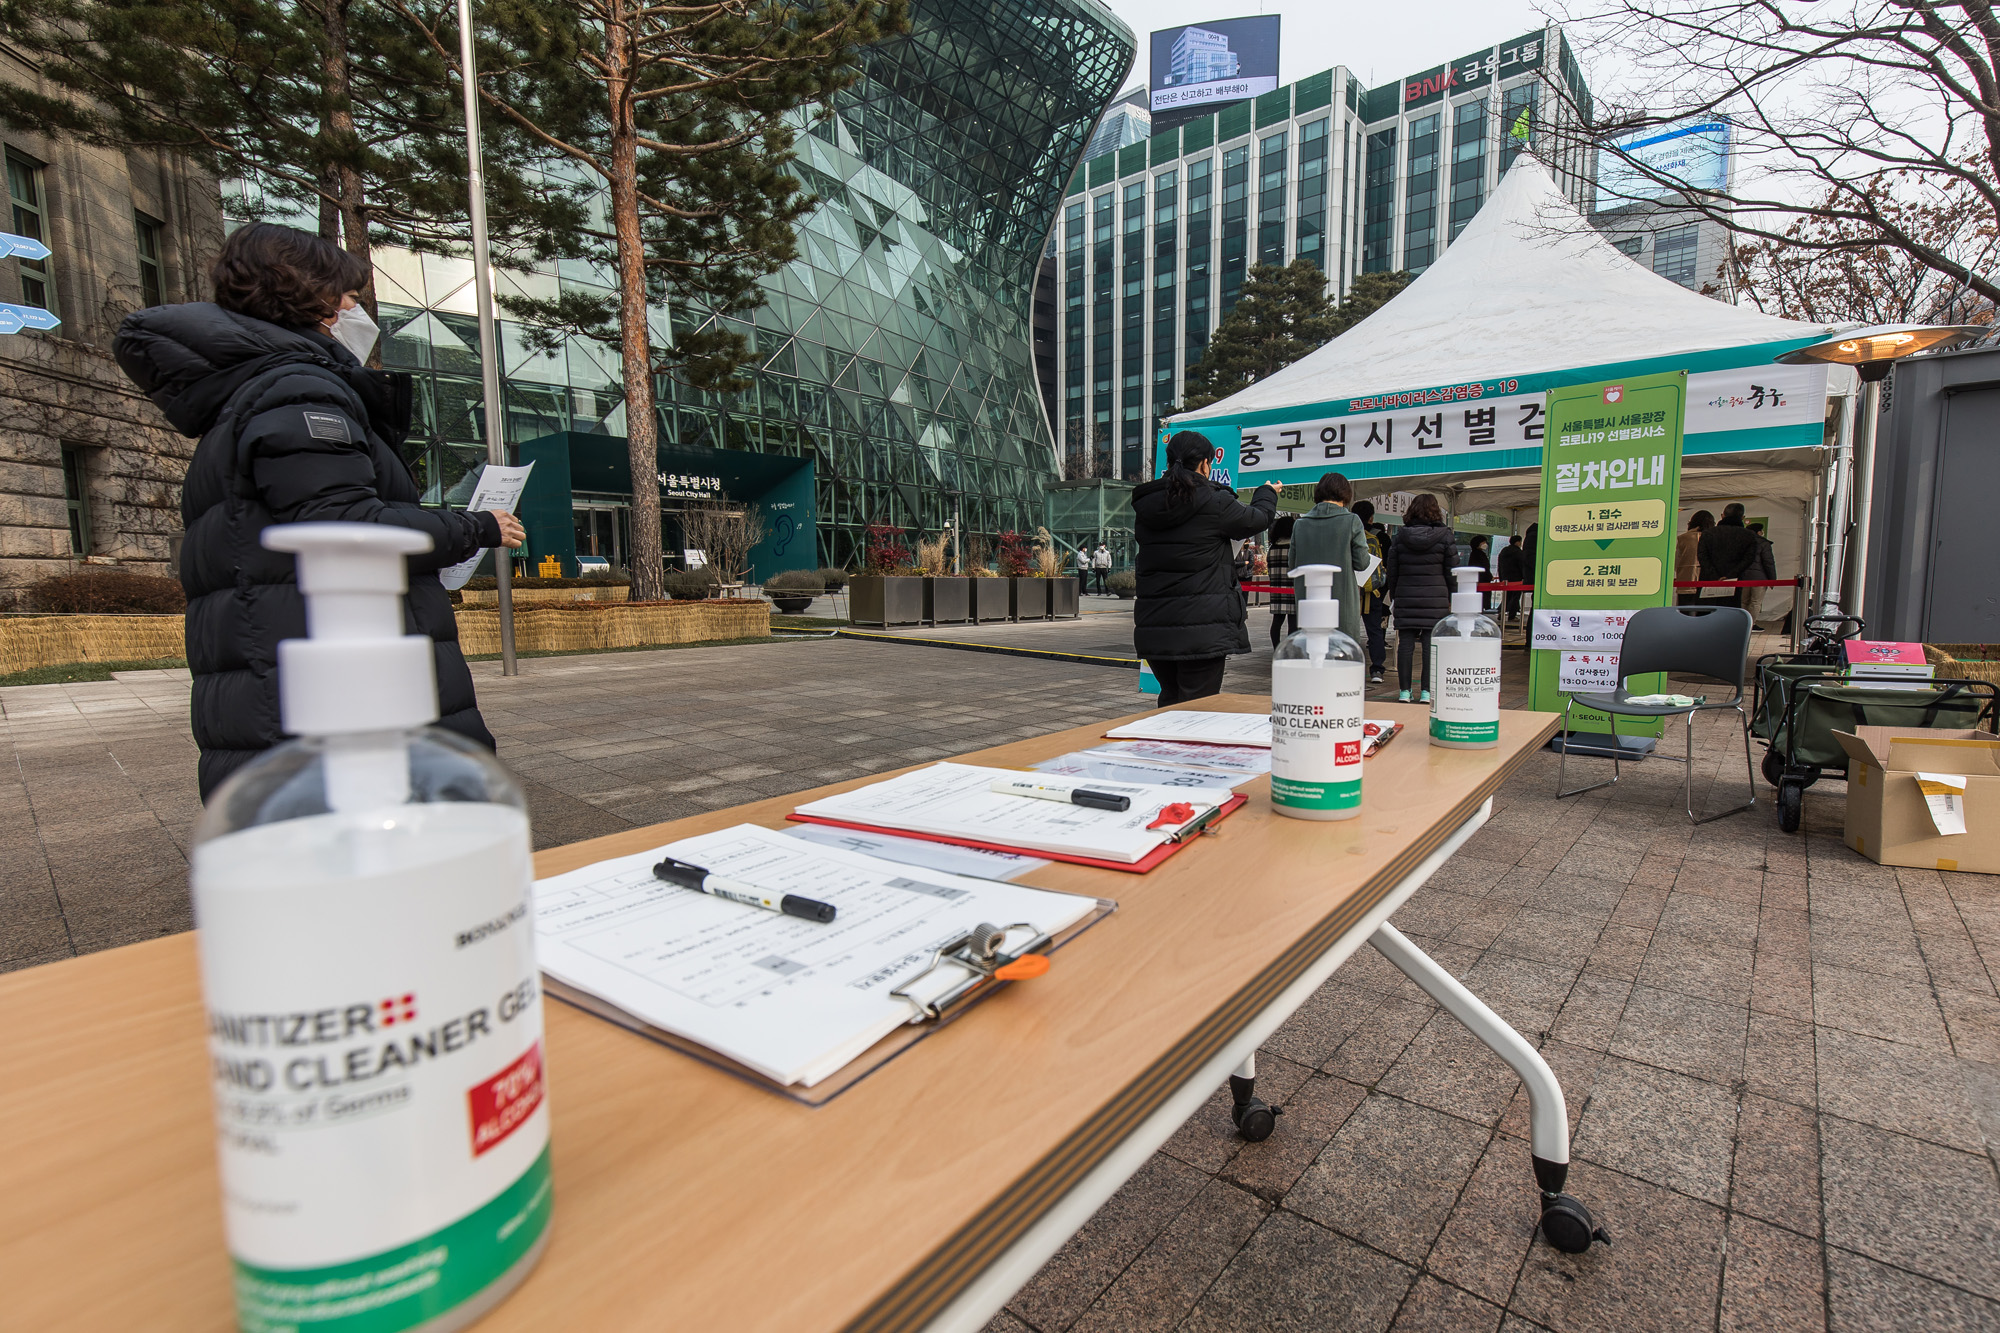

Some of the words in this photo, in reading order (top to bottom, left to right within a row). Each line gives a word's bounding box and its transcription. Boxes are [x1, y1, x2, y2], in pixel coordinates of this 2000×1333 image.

[1405, 68, 1459, 103] BNK
[1462, 38, 1543, 83] 금융그룹
[1154, 92, 1179, 105] 전단은
[1180, 88, 1213, 101] 신고하고
[1215, 83, 1249, 96] 배부해야
[1348, 384, 1484, 413] 코로나바이러스감염증
[1499, 379, 1519, 394] 19
[1747, 384, 1784, 409] 중구
[1561, 416, 1615, 433] 서울특별시
[1618, 410, 1666, 426] 서울광장
[1559, 431, 1605, 447] 코로나19
[1607, 425, 1665, 442] 선별검사소
[1555, 454, 1665, 493] 절차안내
[657, 473, 721, 491] 서울특별시청
[667, 489, 685, 497] Seoul
[685, 490, 698, 499] City
[698, 491, 711, 499] Hall
[1587, 510, 1595, 520] 1.
[1599, 508, 1622, 520] 접수
[1555, 523, 1594, 533] 역학조사서
[1596, 523, 1604, 531] 및
[1606, 520, 1640, 531] 검사라벨
[1641, 519, 1659, 529] 작성
[1583, 566, 1594, 576] 2.
[1598, 565, 1621, 576] 검체
[1566, 579, 1584, 587] 검체
[1586, 579, 1604, 587] 채취
[1607, 578, 1615, 587] 및
[1618, 578, 1638, 587] 보관
[1535, 633, 1557, 641] 09:00
[1601, 632, 1624, 640] 10:00
[1446, 667, 1491, 676] SANITIZER
[1575, 668, 1610, 677] (검사중단)
[1445, 677, 1471, 685] HAND
[1473, 675, 1501, 685] CLEANE
[1562, 678, 1618, 687] 13:00~14:0
[1272, 715, 1287, 727] AND
[1289, 717, 1344, 730] CLEANER
[1297, 731, 1320, 739] Germs
[1342, 744, 1358, 755] 70%
[284, 1006, 493, 1092] CLEANER
